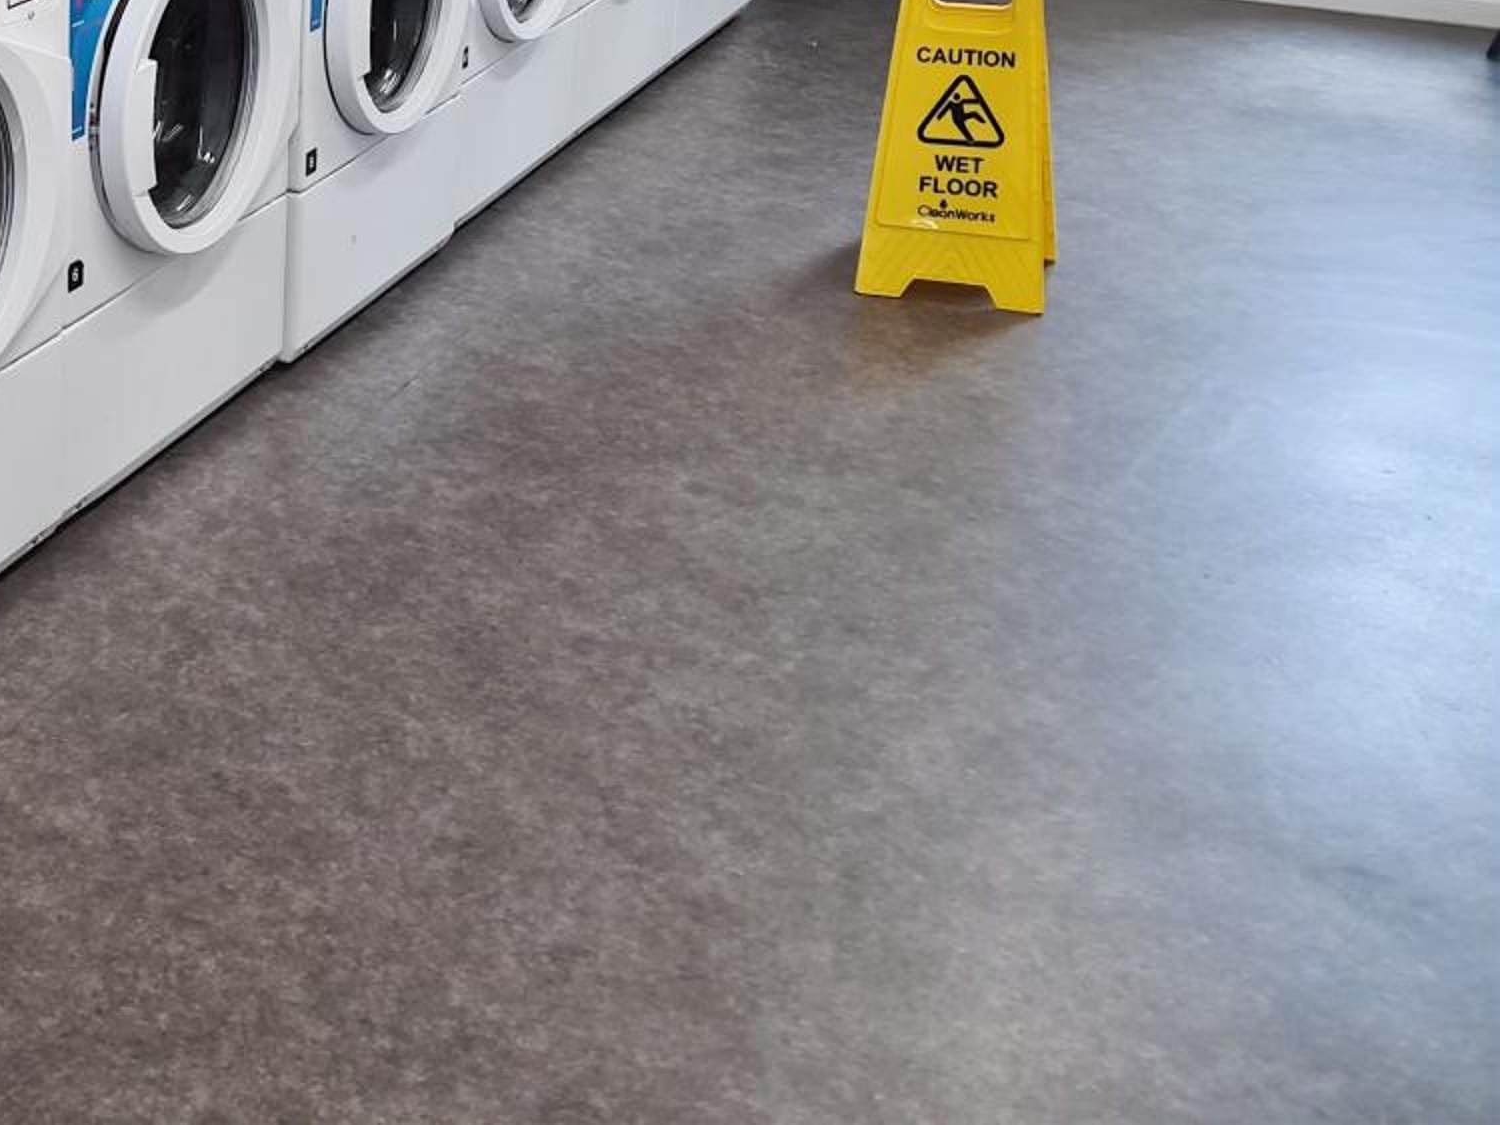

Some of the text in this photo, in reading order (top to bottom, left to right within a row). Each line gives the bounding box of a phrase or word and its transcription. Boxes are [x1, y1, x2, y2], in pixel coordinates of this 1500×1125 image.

[916, 46, 1016, 68] CAUTION
[934, 154, 985, 174] WET
[918, 176, 998, 198] FLOOR
